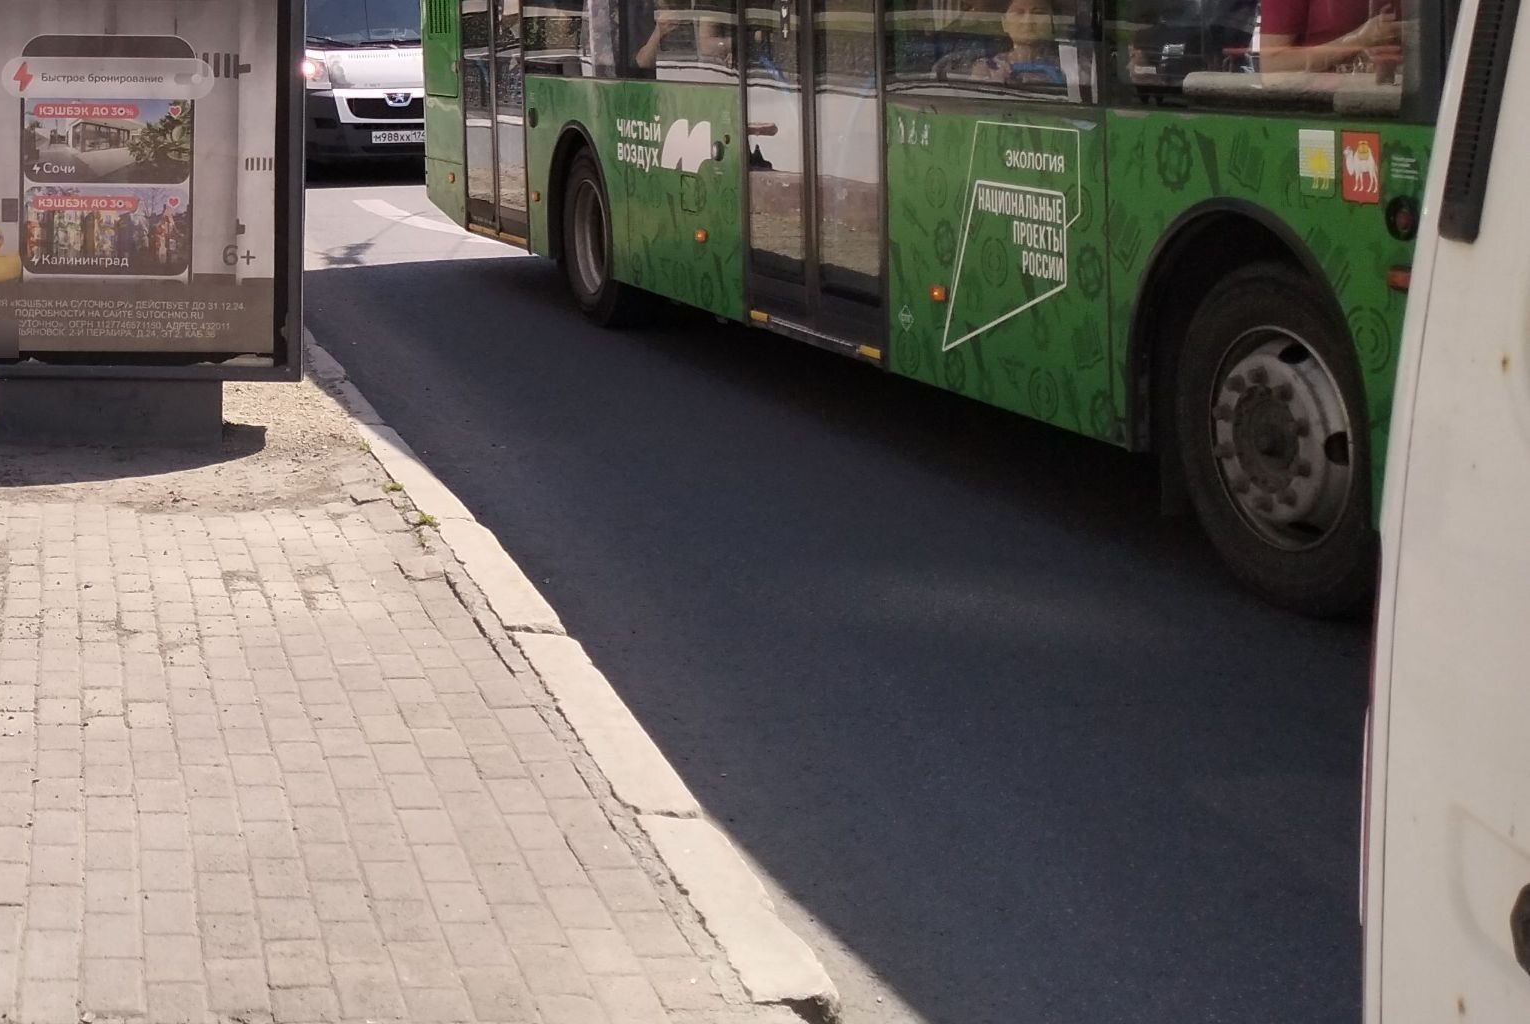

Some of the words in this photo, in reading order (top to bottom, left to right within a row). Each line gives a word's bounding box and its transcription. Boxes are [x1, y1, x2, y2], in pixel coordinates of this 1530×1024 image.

[41, 73, 86, 83] Быстрое
[88, 73, 164, 84] бронирование
[39, 105, 89, 116] КЭШБЭК
[91, 106, 109, 116] ДО
[616, 114, 662, 143] ЧИСТЫЙ
[617, 142, 659, 174] ВОЗДУХ
[1005, 149, 1065, 173] ЭКОЛОГИЯ
[42, 162, 76, 174] Сочи
[38, 198, 88, 209] КЭШБЭК
[90, 199, 108, 209] ДО
[978, 187, 1062, 224] НАЦИОНАЛЬНЫЕ
[1013, 221, 1063, 252] ПРОЕКТЫ
[42, 254, 130, 267] Калининград
[221, 244, 257, 267] 6+
[1022, 250, 1063, 282] РОССИИ
[15, 308, 87, 318] ПОДРОБНОСТИ
[89, 309, 100, 318] НА
[102, 309, 133, 318] САЙТЕ
[55, 300, 68, 308] НА
[135, 301, 190, 310] ДЕЙСТВУЕТ
[191, 302, 206, 310] ДО
